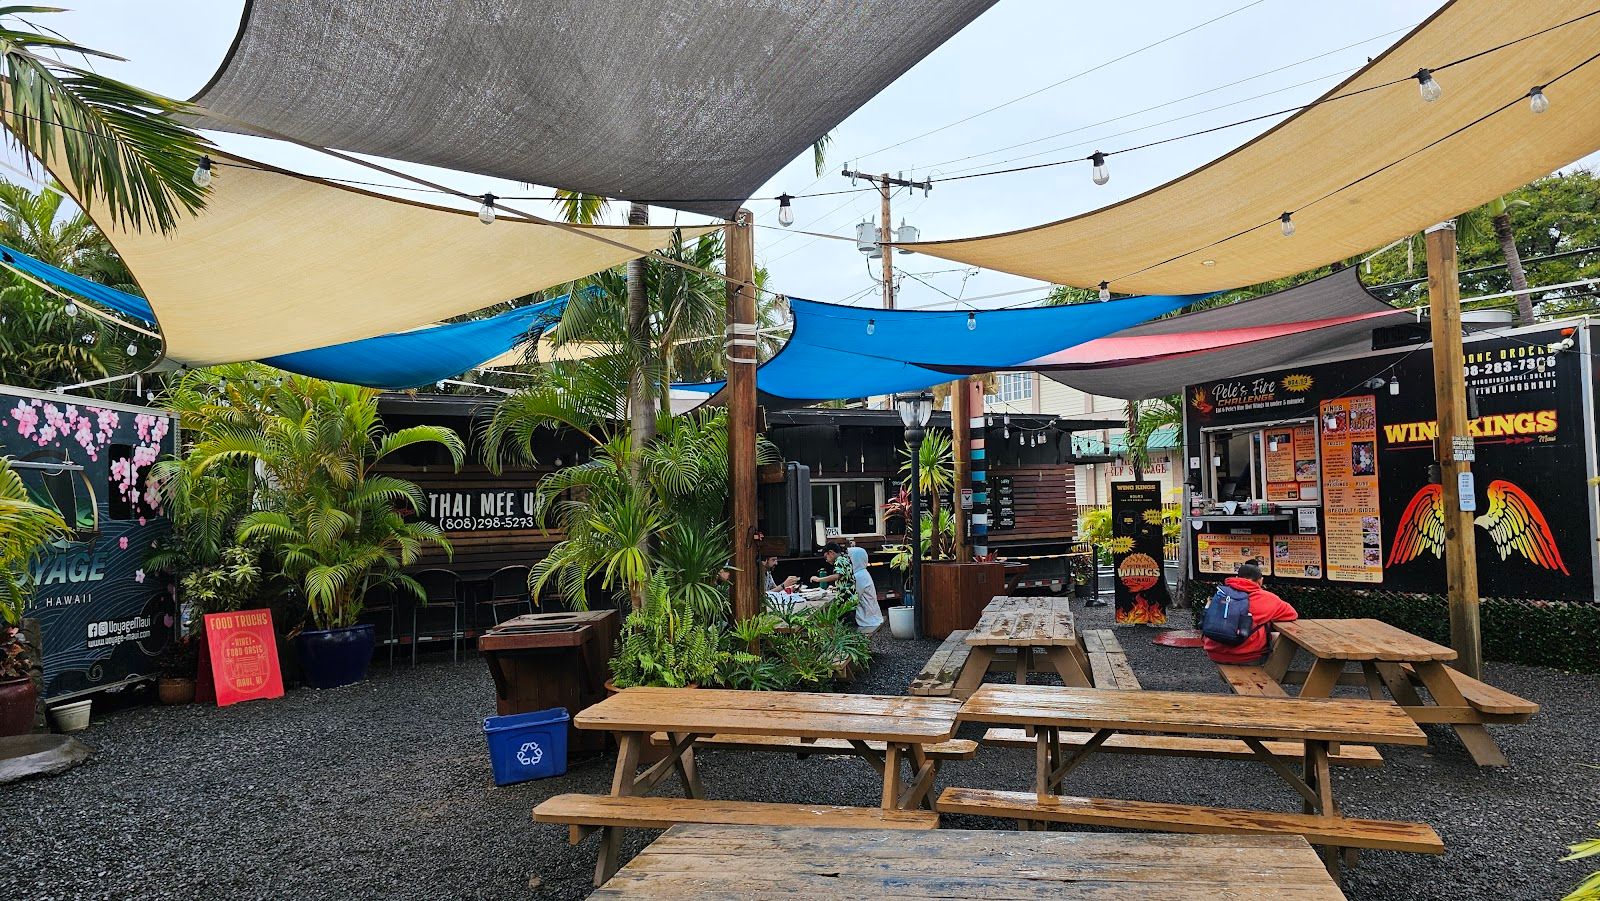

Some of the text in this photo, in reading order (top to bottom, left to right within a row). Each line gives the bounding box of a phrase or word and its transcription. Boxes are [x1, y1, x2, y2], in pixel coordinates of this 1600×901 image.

[1212, 378, 1275, 400] Pele's Fire
[1218, 393, 1275, 407] CHALLENGE
[1384, 410, 1557, 443] WIN KINGS
[428, 492, 471, 518] THAI
[481, 491, 515, 517] MEE
[440, 517, 534, 531] (808)298-5273
[1118, 568, 1161, 577] WINGS
[46, 593, 92, 608] HAWAII
[210, 613, 268, 631] FOOD TRUCKS
[227, 645, 263, 657] FOOD OASIS
